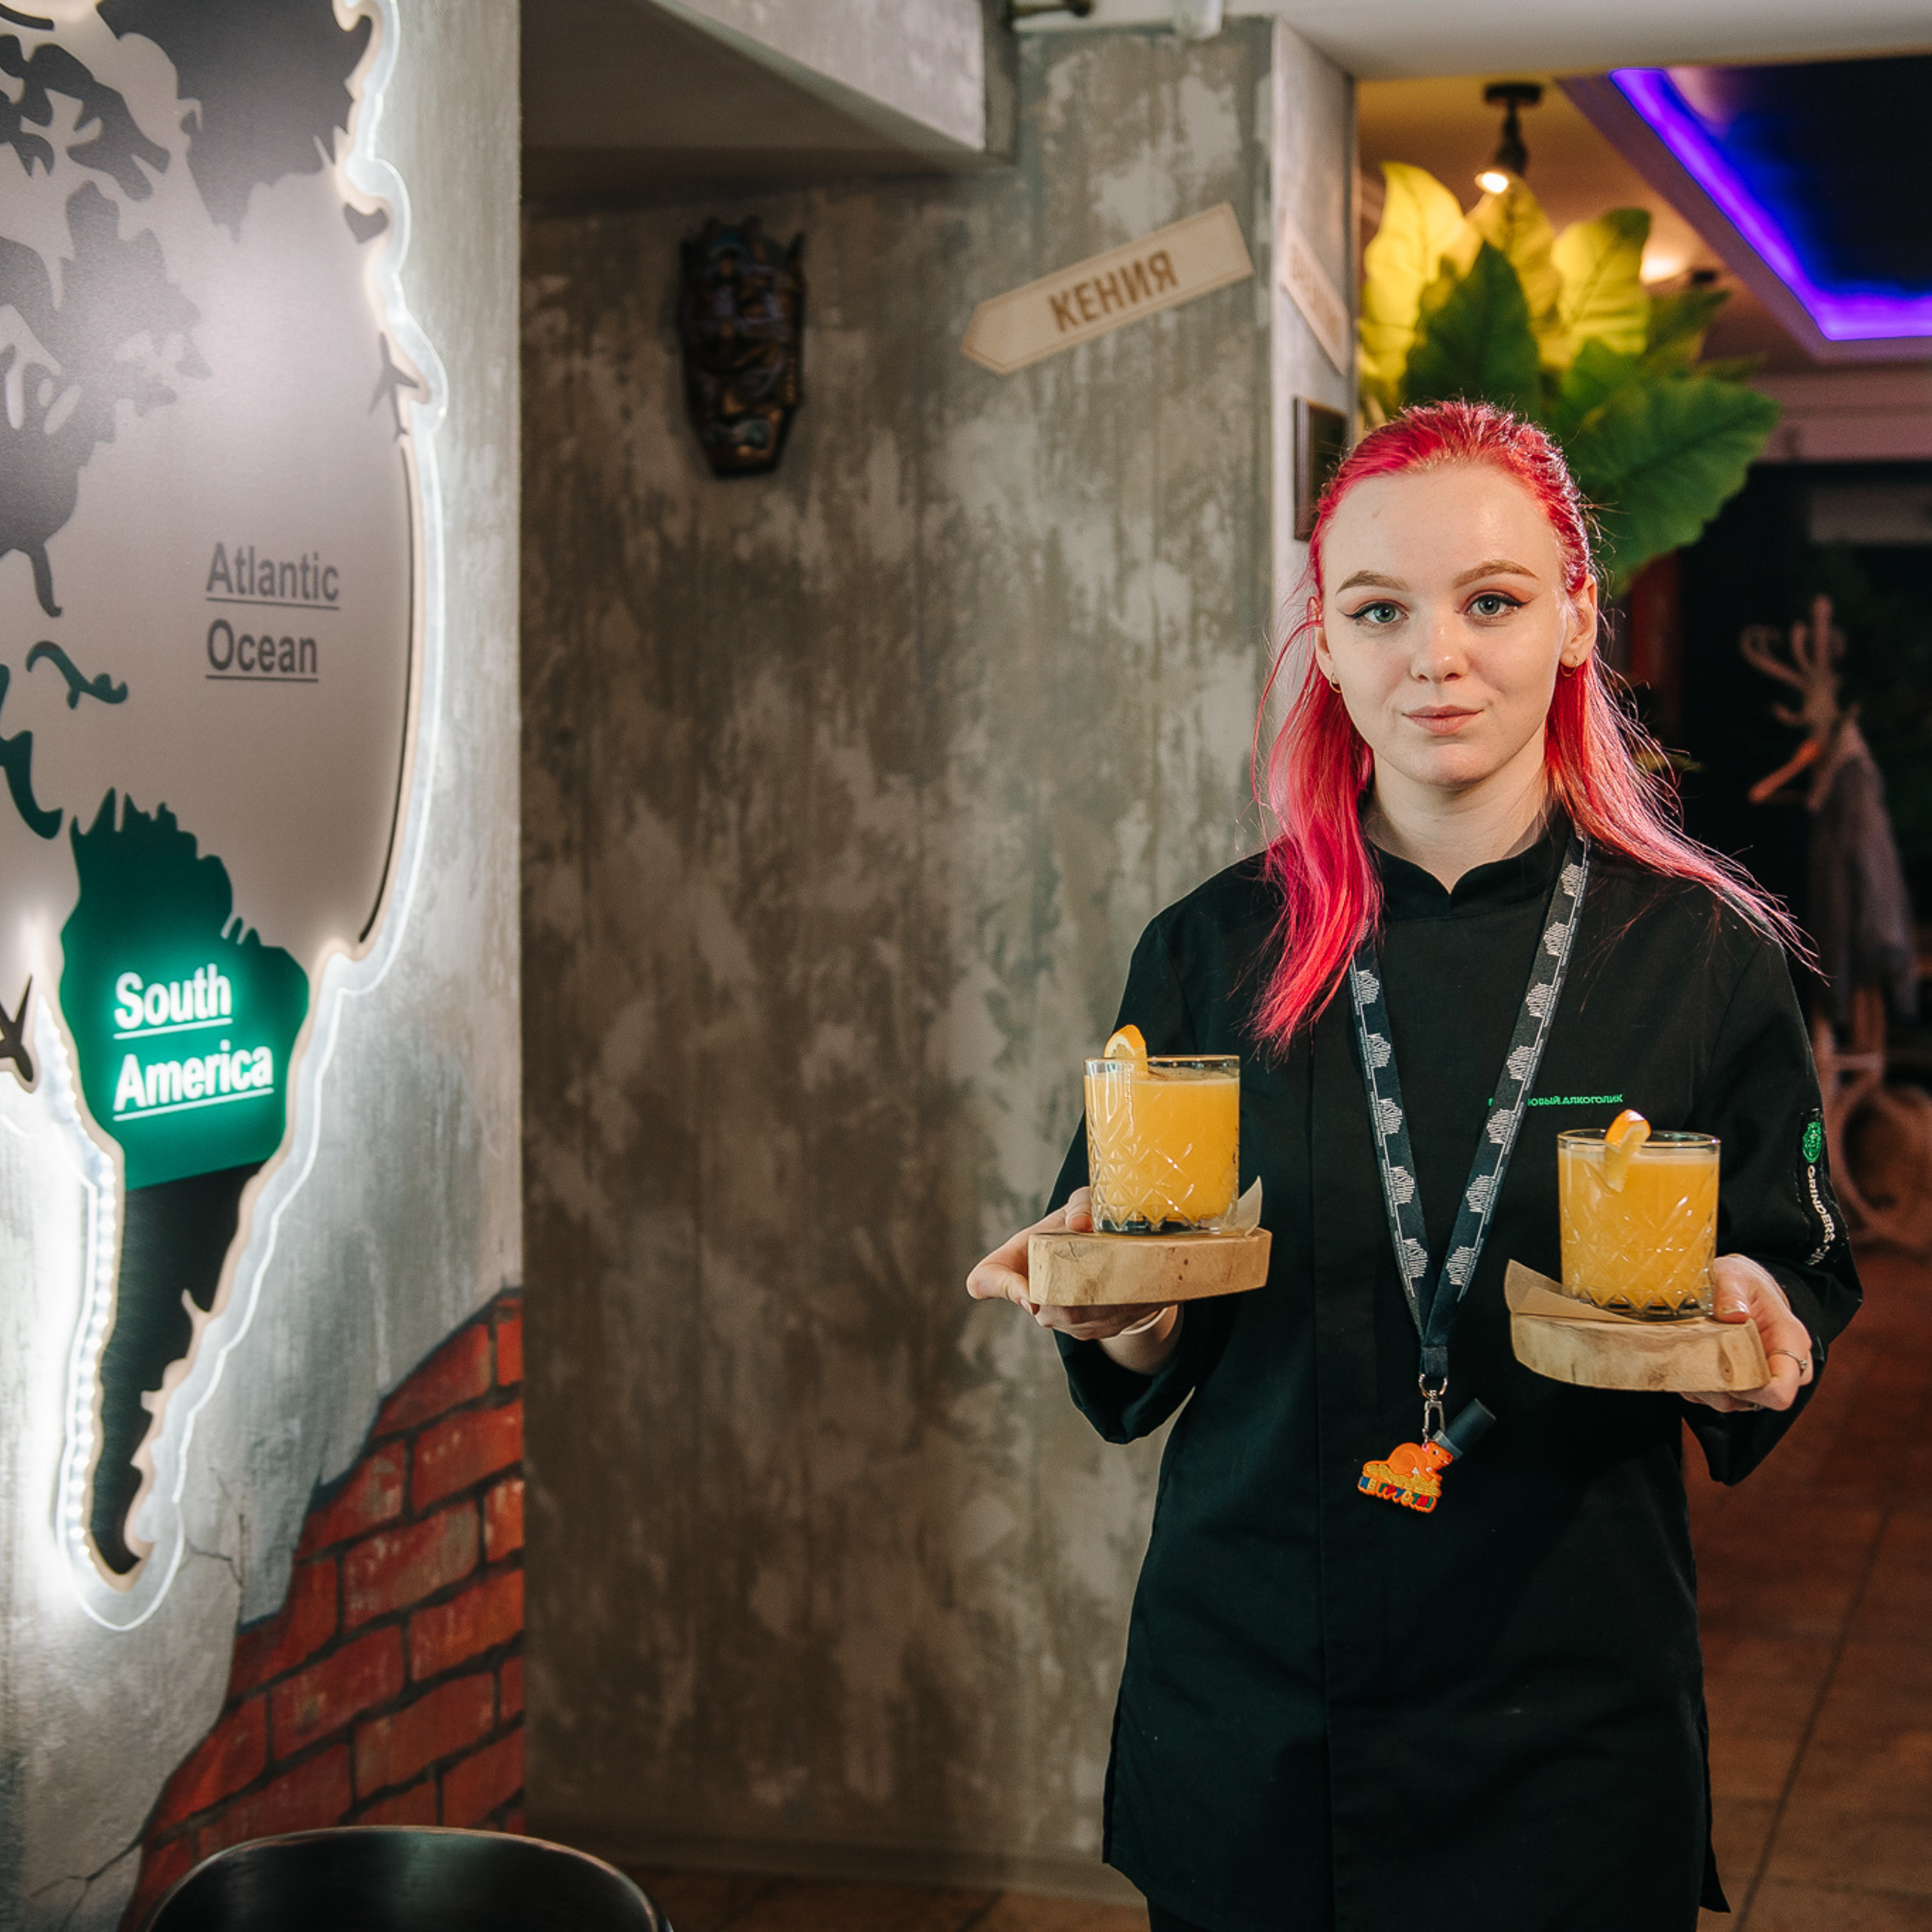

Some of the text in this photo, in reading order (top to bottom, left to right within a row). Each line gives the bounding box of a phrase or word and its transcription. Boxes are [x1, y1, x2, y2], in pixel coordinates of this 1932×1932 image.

[1050, 250, 1178, 332] КЕНИЯ
[206, 543, 340, 601] Atlantic
[206, 619, 318, 674] Ocean
[114, 963, 232, 1030] South
[113, 1039, 273, 1112] America
[1562, 1094, 1623, 1106] АЛКОГОЛИК
[1807, 1164, 1836, 1244] GRINDERS
[1359, 1476, 1434, 1509] НЕ ГРУСТИ!
